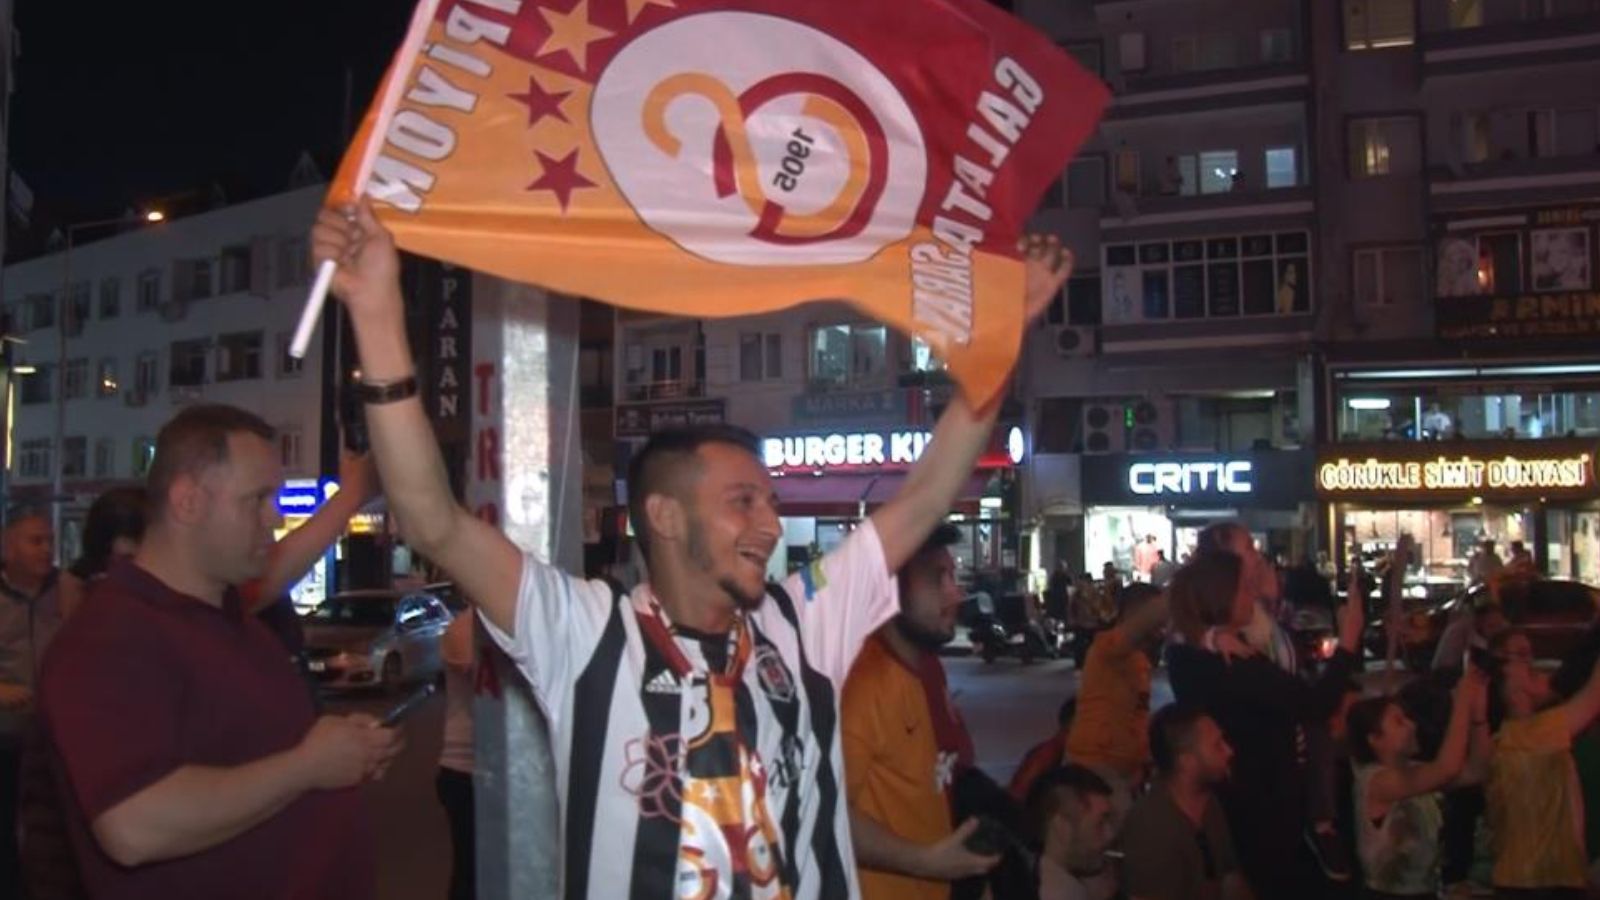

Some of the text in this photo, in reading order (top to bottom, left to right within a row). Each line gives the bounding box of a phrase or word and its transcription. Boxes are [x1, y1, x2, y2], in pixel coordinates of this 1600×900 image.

[763, 433, 884, 467] BURGER
[1129, 461, 1251, 494] CRITIC
[1320, 458, 1421, 489] GÖRÜKLE
[1425, 456, 1485, 488] SİMİT
